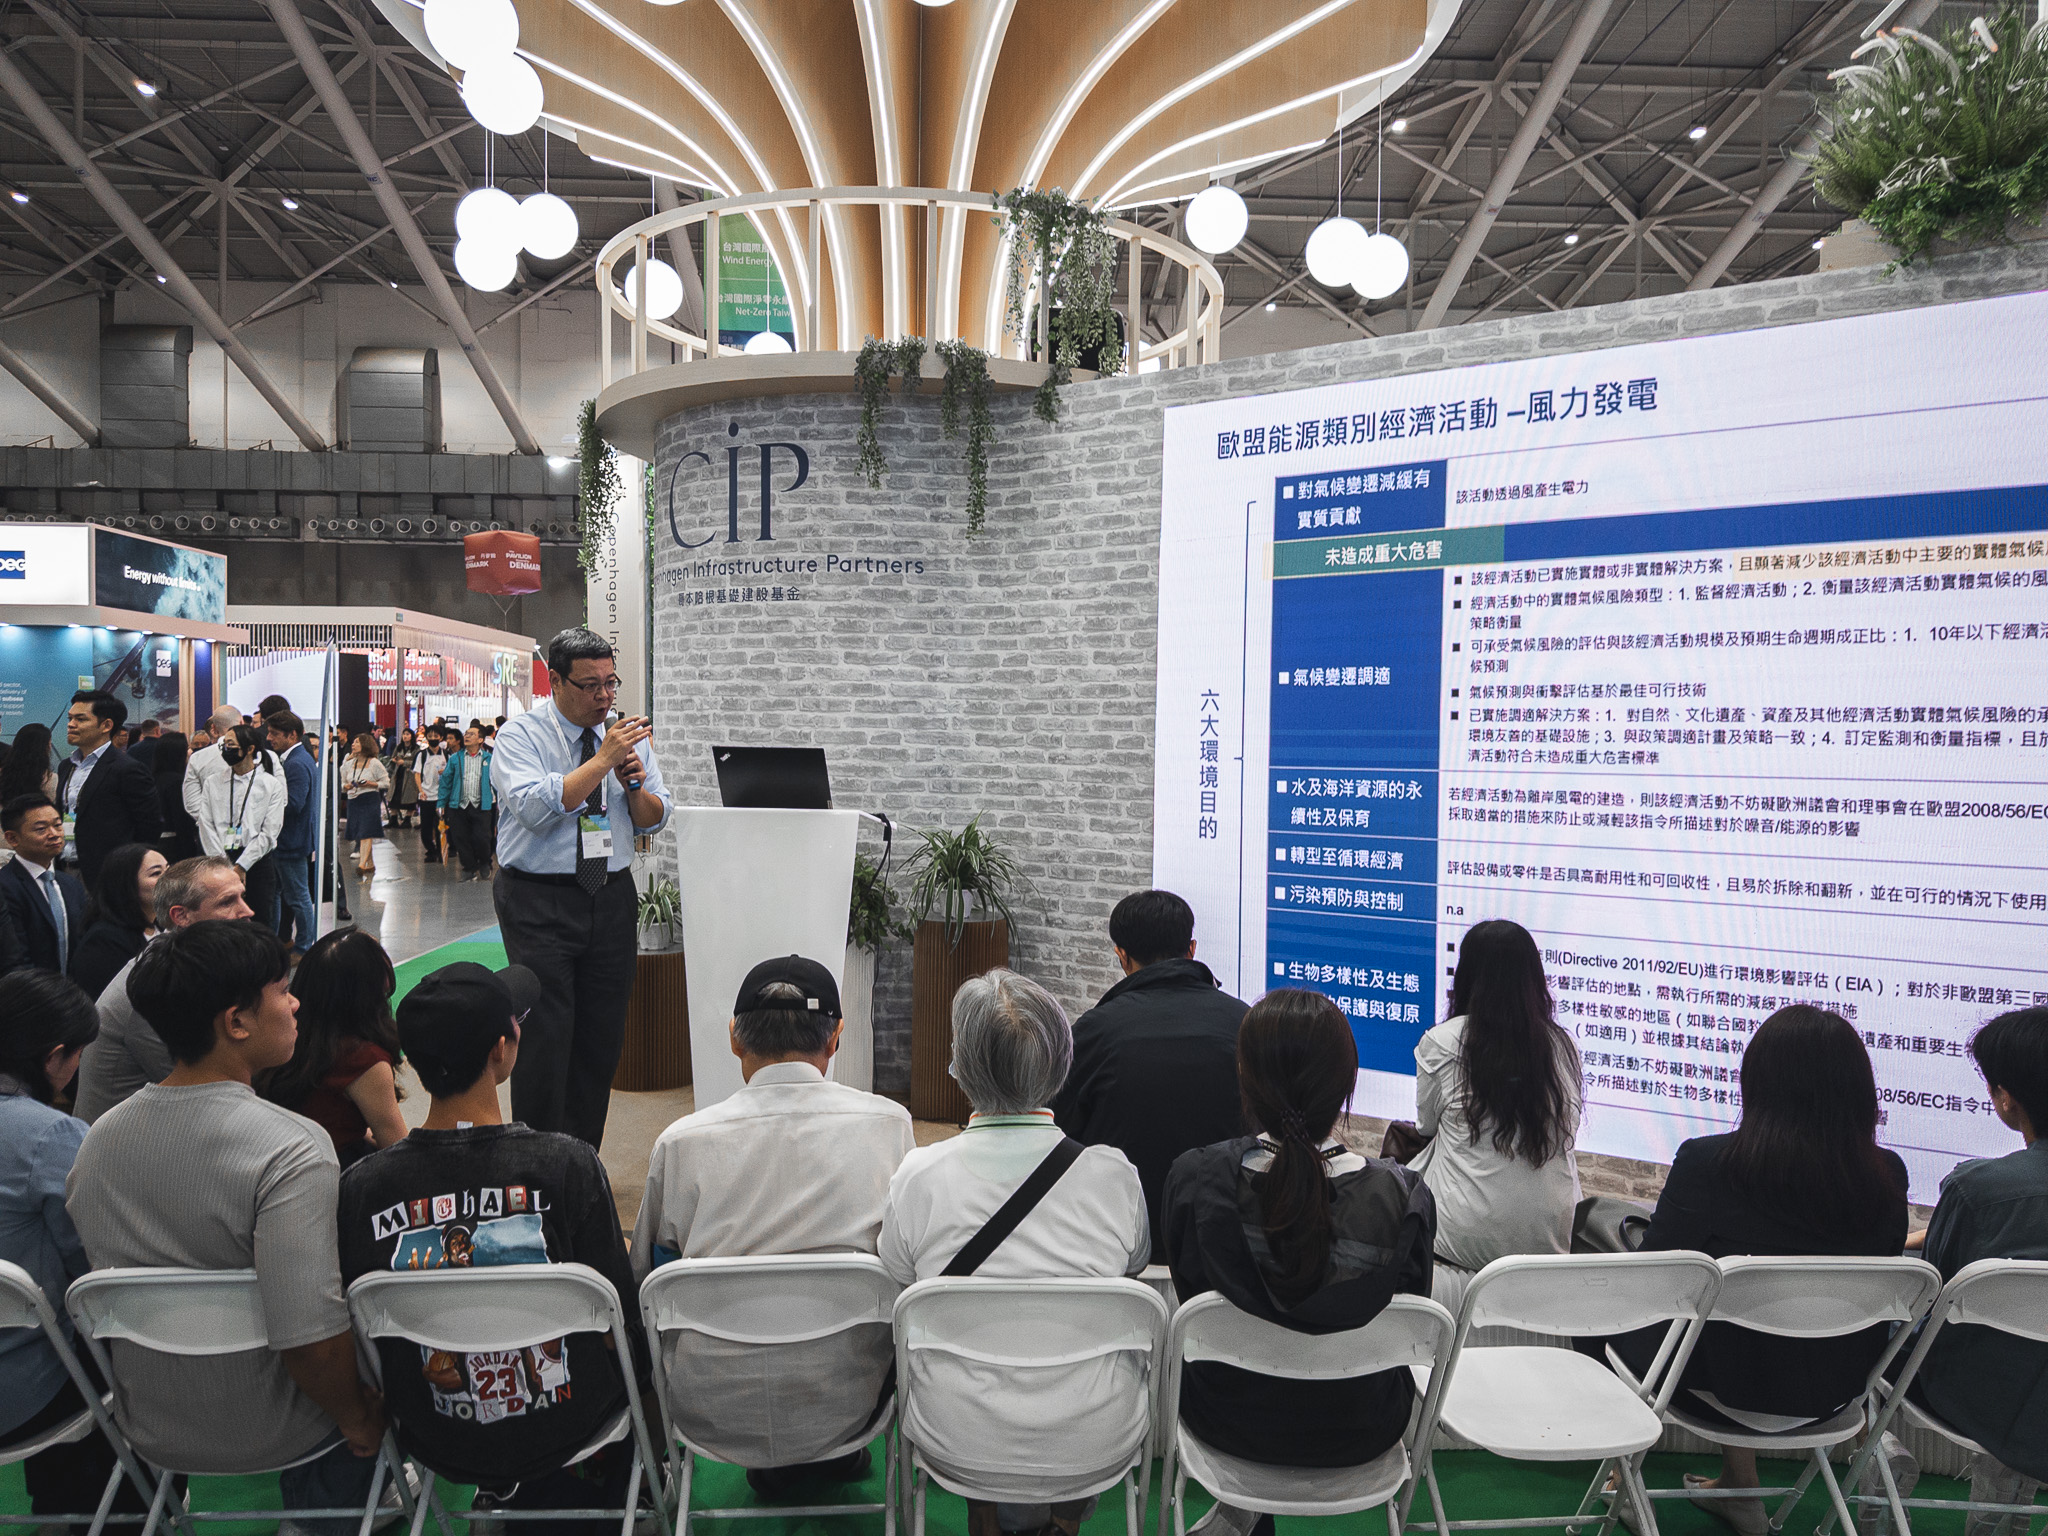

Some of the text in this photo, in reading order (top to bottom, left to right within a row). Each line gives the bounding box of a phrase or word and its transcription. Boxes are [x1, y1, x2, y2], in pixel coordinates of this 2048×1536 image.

[722, 255, 774, 268] Wind Energy
[735, 307, 771, 316] Net-Zero
[1217, 397, 1498, 460] 歐盟能源類別經濟活動
[1297, 468, 1431, 500] 對氣候變遷減緩有
[1456, 480, 1589, 505] 該活動透過風產生電力
[1297, 506, 1362, 530] 實質貢獻
[1325, 541, 1443, 566] 未造成重大危害
[124, 564, 152, 585] Energy
[152, 571, 178, 588] without
[694, 556, 818, 579] Infrastructure
[826, 554, 925, 575] Partners
[1470, 614, 1522, 631] 策略衡量
[1293, 665, 1391, 688] 氣候變遷調適
[1470, 658, 1509, 674] 候預測
[1198, 688, 1220, 840] 六大環境目的
[1291, 777, 1423, 800] 水及海洋資源的永
[1290, 807, 1371, 829] 續性及保育
[1290, 846, 1404, 871] 轉型至循環經濟
[1289, 884, 1404, 912] 污染預防與控制
[1288, 961, 1420, 993] 生物多樣性及生態
[1580, 1049, 1740, 1083] 經濟活動不妨礙歐洲議會
[475, 1367, 517, 1401] 23
